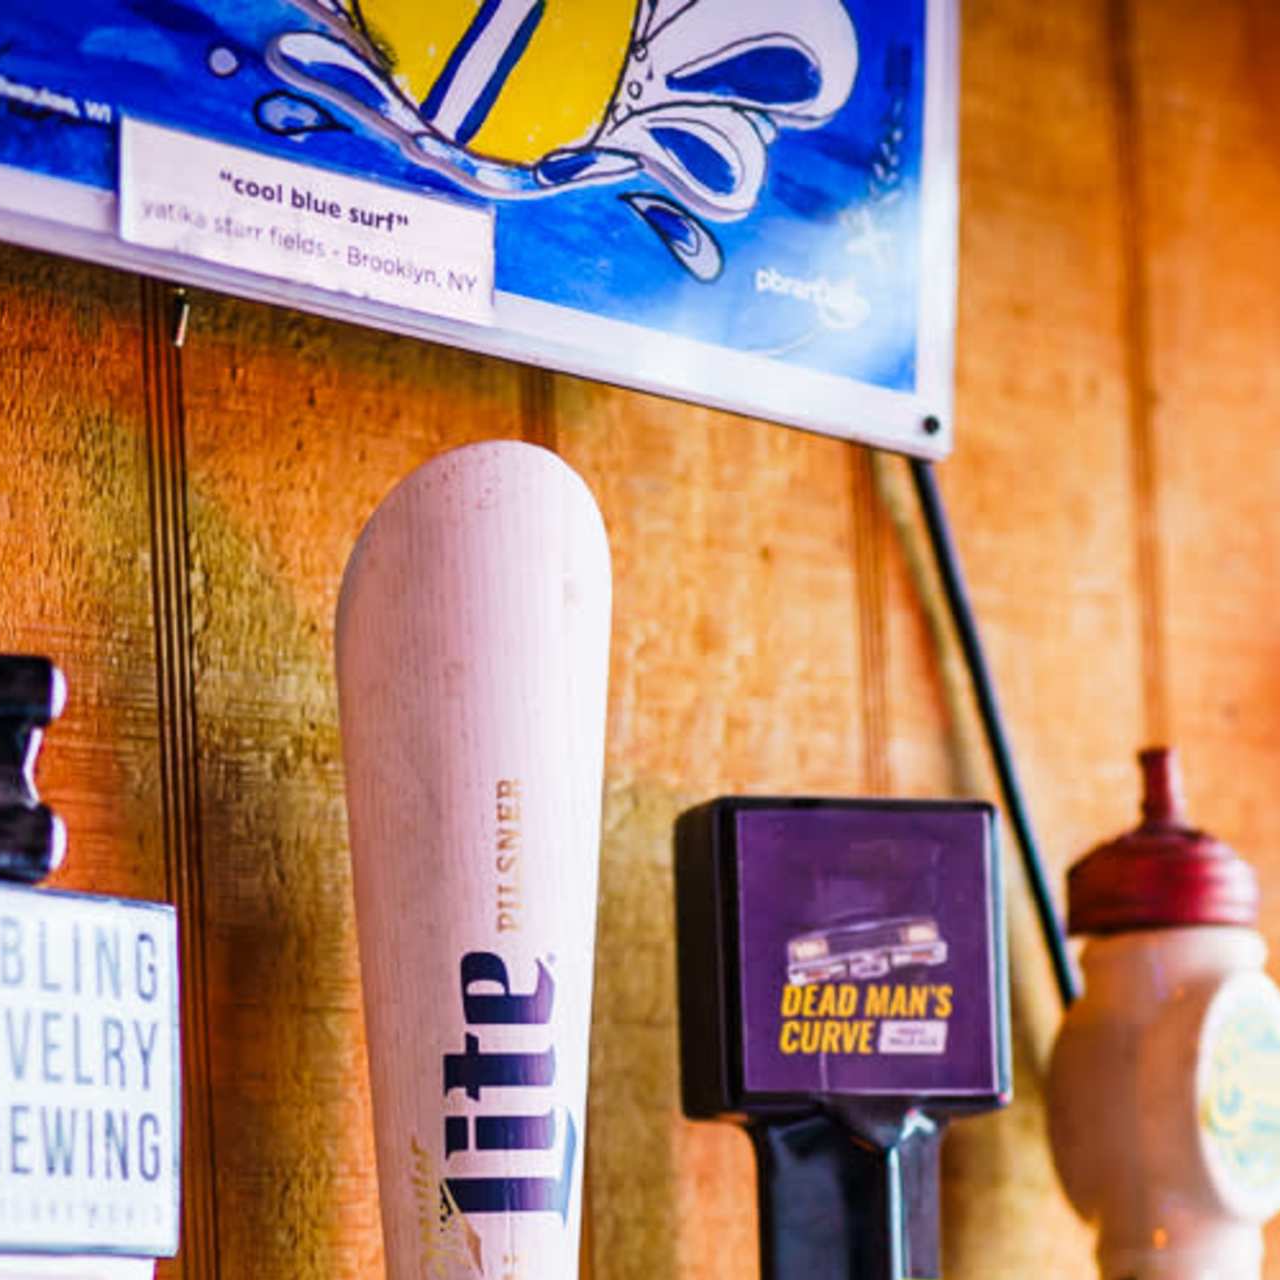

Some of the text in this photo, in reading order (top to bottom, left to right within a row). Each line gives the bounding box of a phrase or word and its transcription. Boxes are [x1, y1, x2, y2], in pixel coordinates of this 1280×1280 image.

[84, 99, 112, 123] WI
[291, 188, 342, 219] blue
[270, 226, 325, 258] fields
[447, 270, 477, 292] NY
[495, 778, 523, 934] PILSNER
[780, 982, 954, 1019] DEAD MAN'S
[779, 1019, 876, 1055] CURVE
